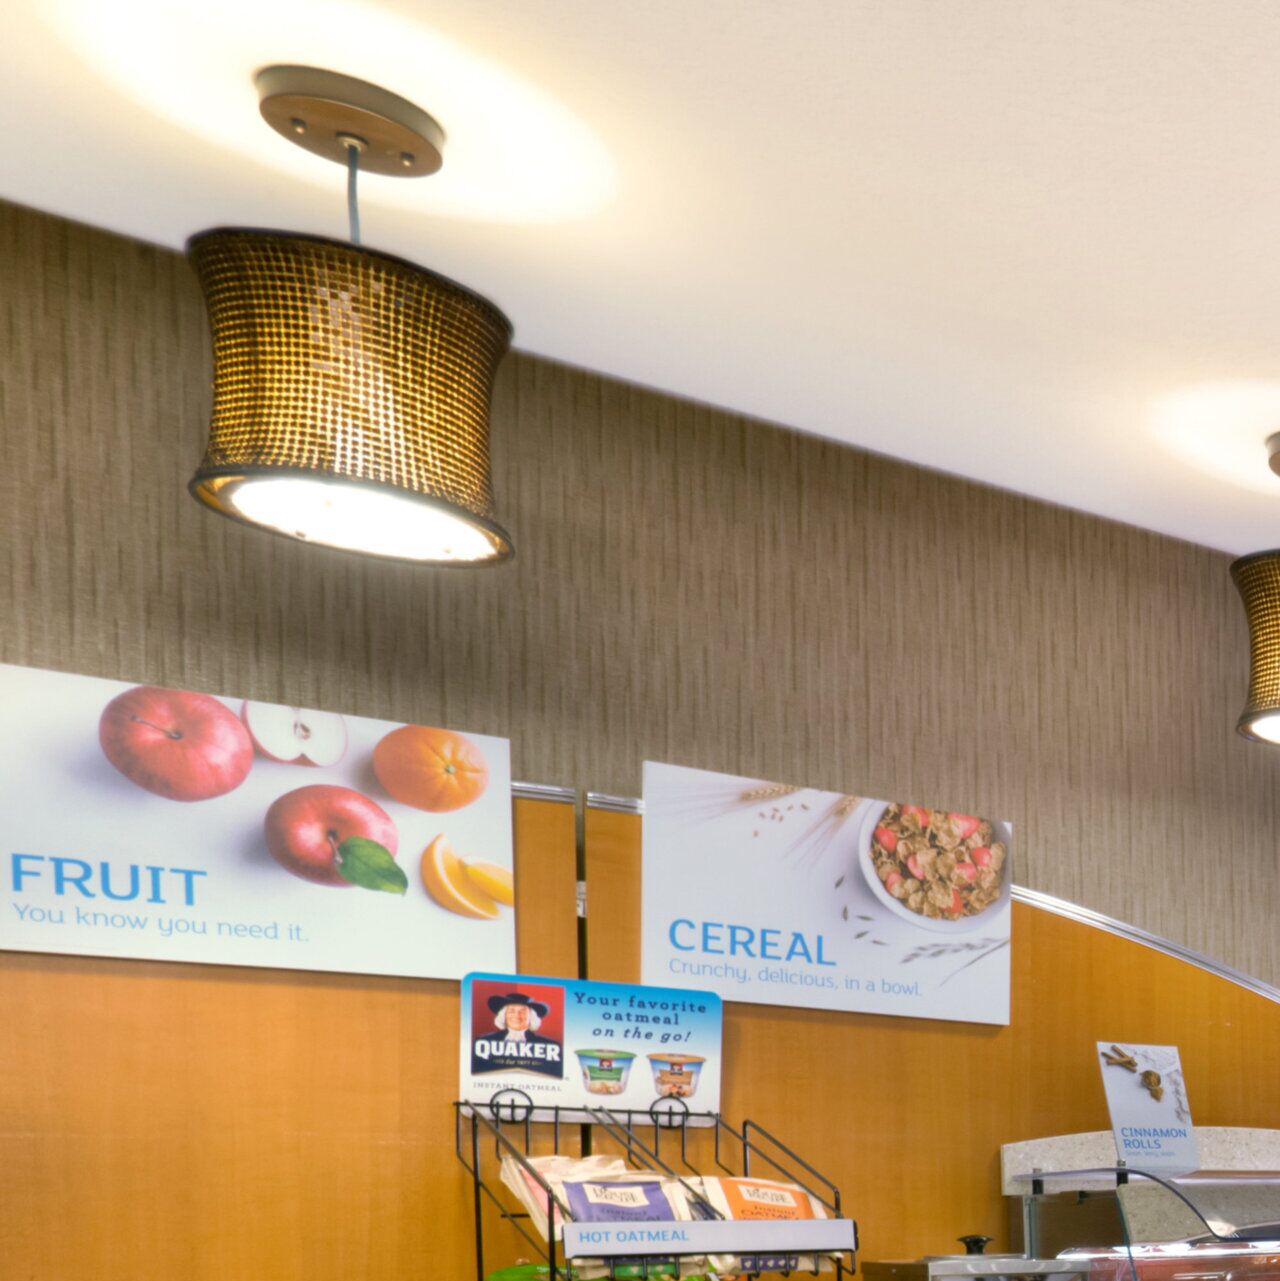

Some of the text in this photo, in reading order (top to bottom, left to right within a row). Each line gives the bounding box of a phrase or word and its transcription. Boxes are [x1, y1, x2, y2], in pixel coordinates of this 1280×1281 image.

[11, 853, 208, 906] FRUIT
[12, 902, 310, 942] You know you need it.
[668, 918, 837, 967] CEREAL
[668, 957, 922, 997] Crunchy, delicious, in a bowl.
[574, 992, 707, 1014] Your favorite
[602, 1012, 680, 1025] oatmeal
[592, 1026, 692, 1044] on the go!
[475, 1039, 561, 1062] QUAKER
[473, 1081, 562, 1092] INSTANT OATMEAL
[1121, 1127, 1187, 1138] CINNAMON
[1123, 1138, 1161, 1149] ROLLS
[579, 1229, 689, 1243] HOT OATMEAL
